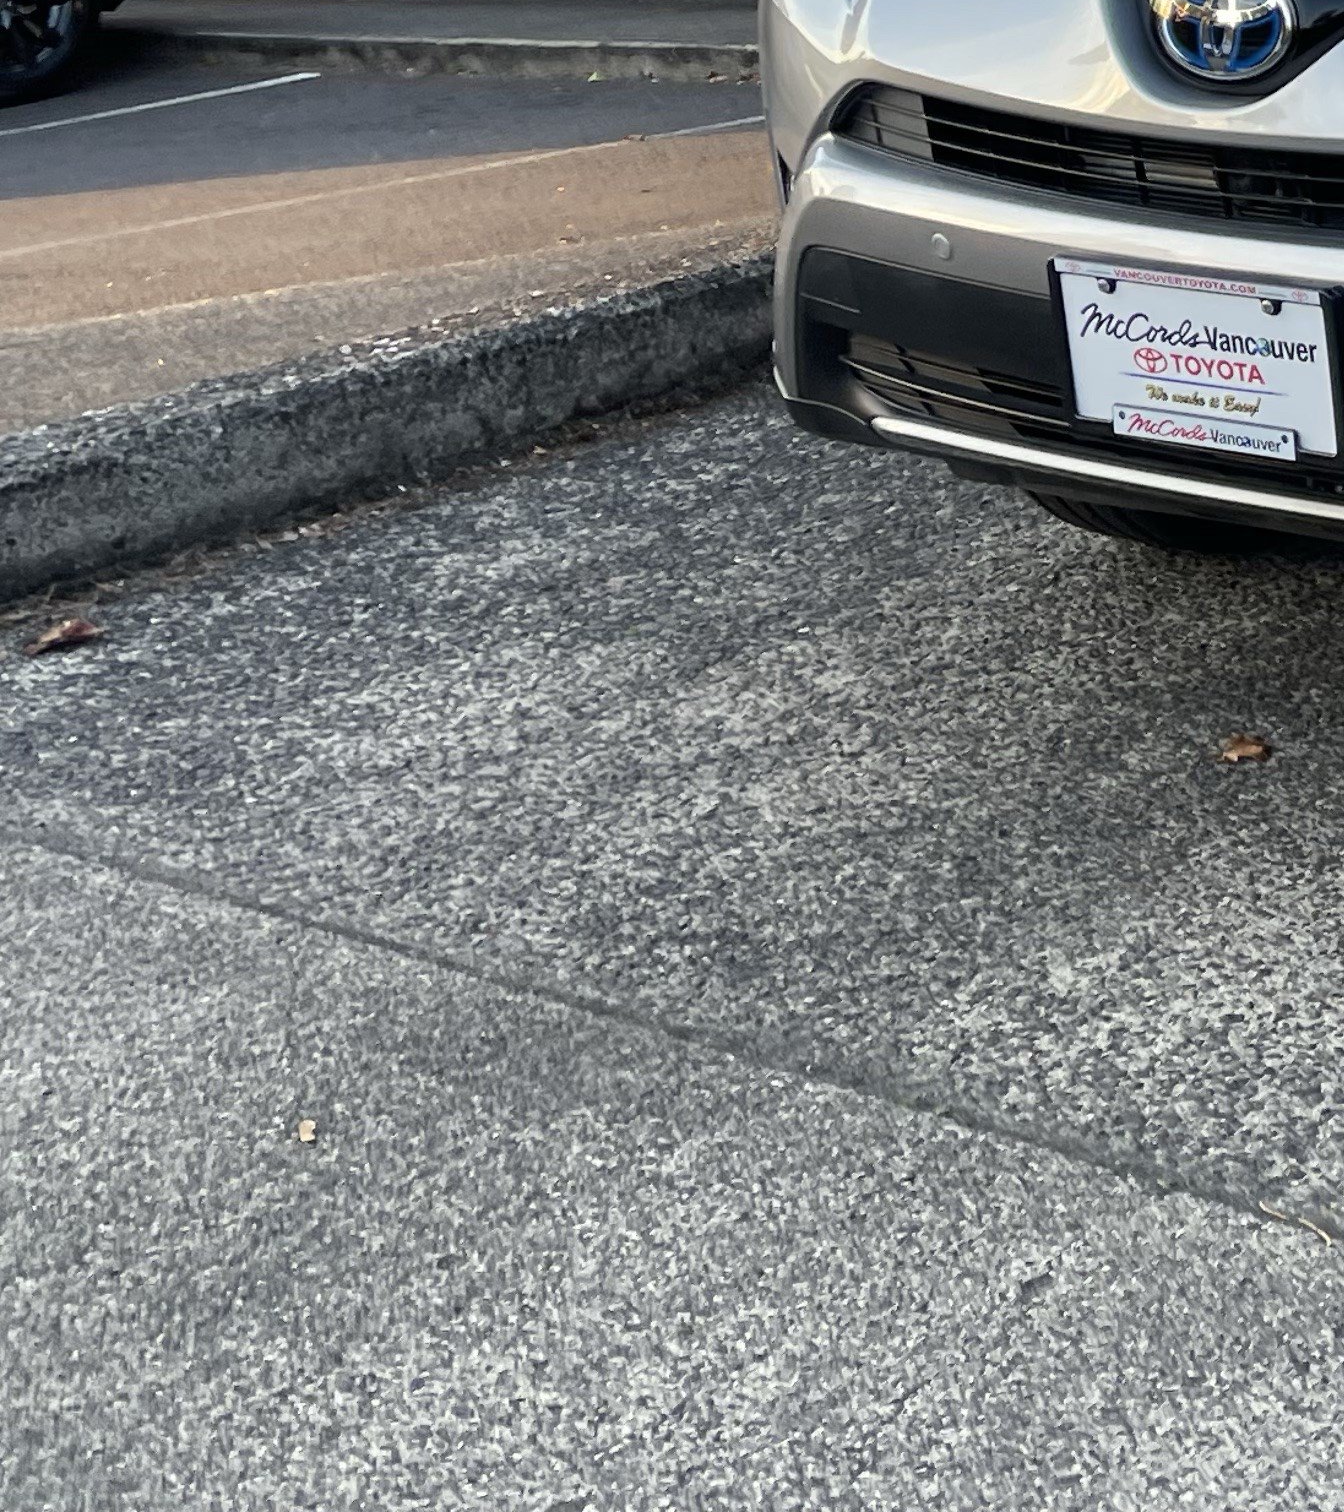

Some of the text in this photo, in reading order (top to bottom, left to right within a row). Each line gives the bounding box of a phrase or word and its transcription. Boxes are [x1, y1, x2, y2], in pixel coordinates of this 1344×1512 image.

[1113, 268, 1257, 295] VANCOUVERTOYOTA.COM
[1202, 325, 1318, 363] Vancouver
[1169, 353, 1267, 385] TOYOTA
[1208, 428, 1282, 453] Vancouver
